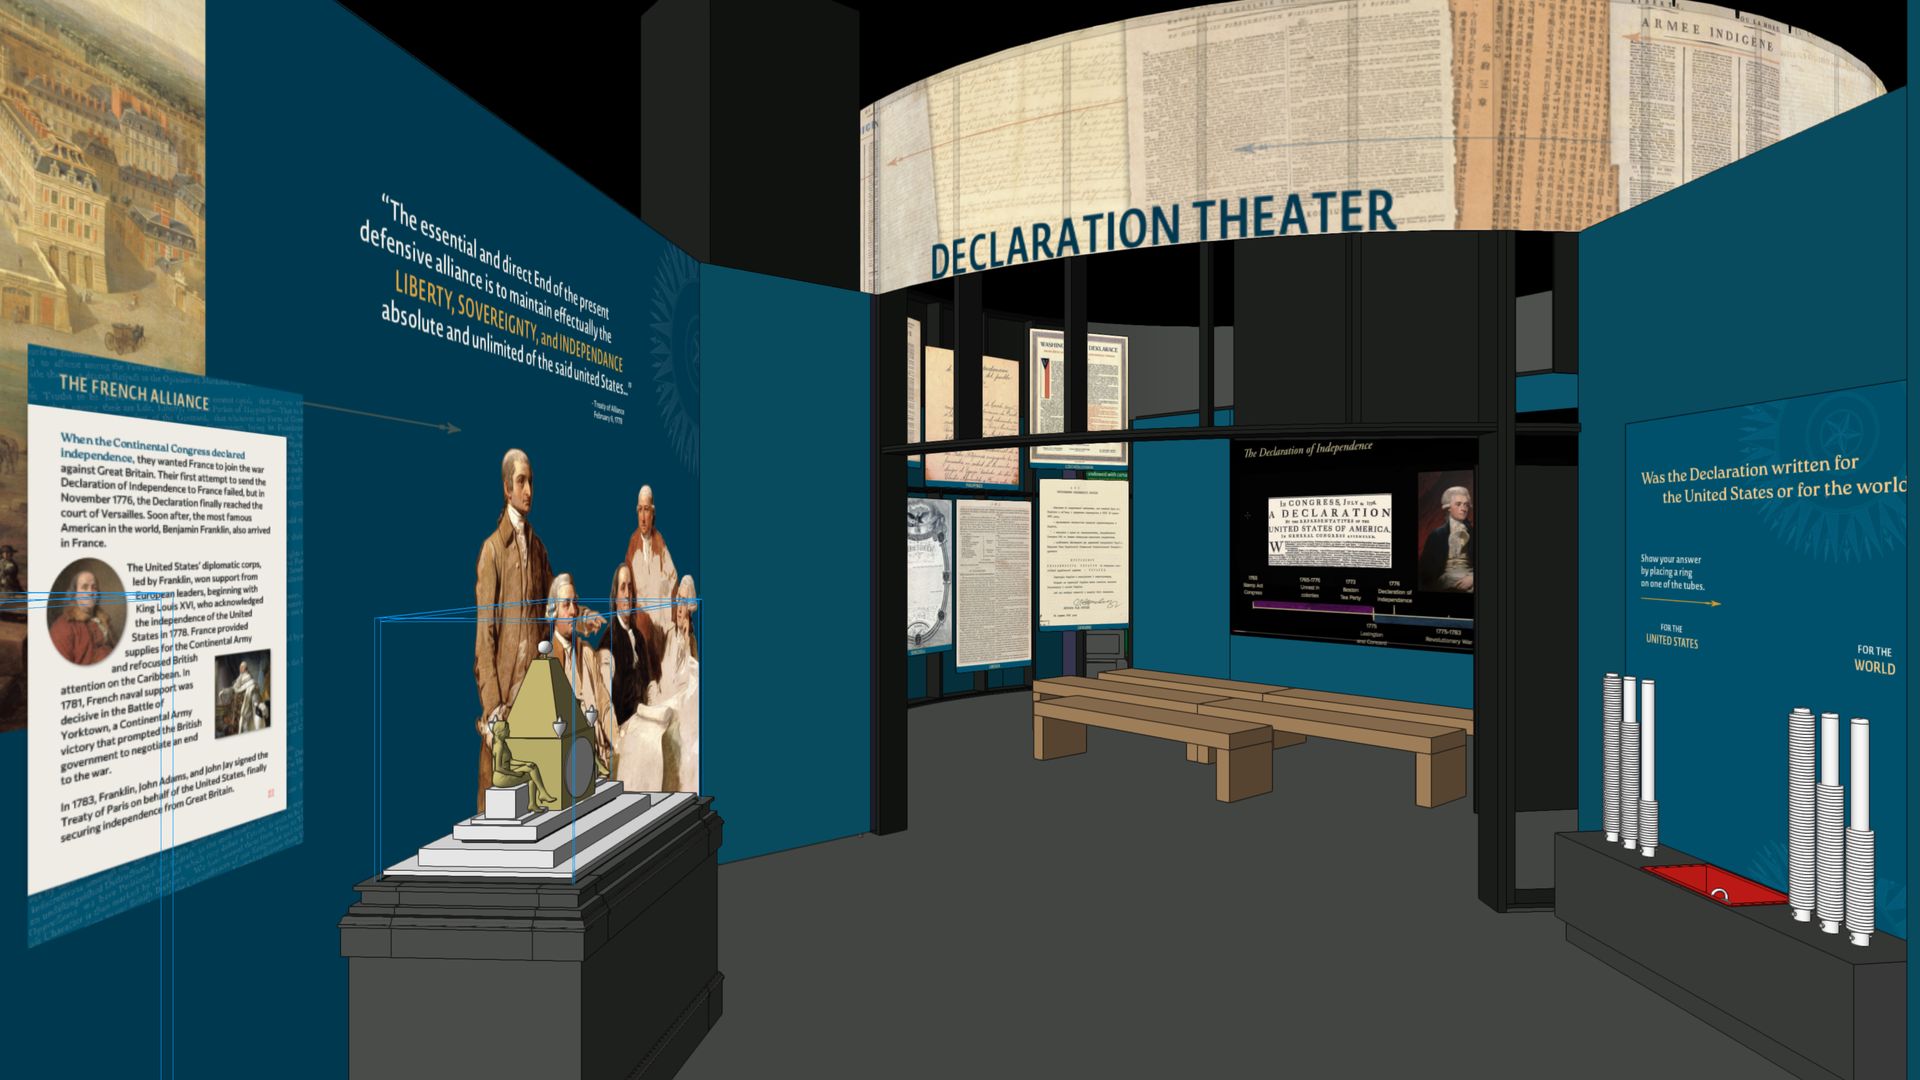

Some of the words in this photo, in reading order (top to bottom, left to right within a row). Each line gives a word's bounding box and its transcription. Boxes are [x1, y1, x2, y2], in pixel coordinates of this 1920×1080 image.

[1642, 18, 1700, 35] ARMEE
[1710, 26, 1774, 52] INDIGENE
[931, 204, 1180, 280] DECLARATION
[1192, 189, 1398, 241] THEATER
[421, 220, 476, 258] essential
[480, 248, 500, 269] and
[503, 255, 532, 284] direct
[535, 271, 551, 293] End
[553, 280, 563, 298] of
[564, 286, 578, 306] the
[580, 297, 609, 320] present
[360, 220, 432, 269] defensive
[436, 254, 482, 289] alliance
[486, 274, 493, 294] is
[496, 282, 507, 299] to
[510, 290, 552, 318] maintain
[554, 307, 598, 341] effectually
[600, 326, 611, 343] the
[395, 270, 455, 315] LIBERTY,
[459, 295, 538, 344] SOVEREIGNTY,
[541, 331, 558, 351] and
[559, 334, 623, 373] INDEPENDANCE
[382, 300, 443, 337] absolute
[447, 326, 469, 345] and
[473, 333, 524, 362] unlimited
[526, 350, 537, 368] of
[538, 352, 553, 372] the
[556, 361, 572, 378] said
[574, 368, 599, 386] united
[60, 374, 87, 392] THE
[92, 380, 147, 400] FRENCH
[151, 390, 208, 410] ALLIANCE
[61, 432, 93, 445] When
[95, 437, 112, 446] the
[114, 439, 169, 452] Continental
[171, 444, 210, 456] Congress
[212, 449, 245, 459] declared
[1245, 449, 1257, 458] The
[1260, 446, 1304, 457] Declaration
[1306, 443, 1316, 456] of
[1317, 440, 1373, 455] Independence
[61, 448, 135, 464] independence,
[137, 455, 156, 466] they
[158, 459, 188, 468] wanted
[189, 460, 214, 470] France
[216, 462, 224, 471] to
[225, 462, 238, 472] join
[239, 464, 251, 473] the
[1642, 472, 1665, 484] Was
[1668, 470, 1687, 482] the
[1690, 464, 1768, 481] Declaration
[1772, 459, 1830, 475] written
[1836, 455, 1859, 470] for
[61, 464, 96, 475] against
[98, 466, 123, 477] Great
[126, 468, 156, 479] Britain.
[158, 470, 179, 480] Their
[180, 472, 196, 482] first
[198, 475, 228, 485] attempt
[229, 476, 237, 484] to
[255, 478, 266, 486] the
[1664, 491, 1682, 503] the
[1685, 487, 1727, 502] United
[1731, 486, 1773, 500] States
[1778, 488, 1793, 498] or
[1798, 482, 1820, 497] for
[1825, 480, 1852, 496] the
[1269, 511, 1275, 519] A
[1282, 508, 1391, 518] DECLARATION
[1289, 499, 1341, 507] CONGRESS,
[1349, 525, 1391, 533] AMERICA,
[127, 563, 143, 572] The
[145, 562, 173, 572] United
[174, 562, 201, 571] States'
[202, 561, 240, 571] diplomatic
[242, 562, 262, 570] corps,
[1660, 557, 1674, 565] your
[1642, 568, 1649, 576] by
[1650, 568, 1673, 578] placing
[1680, 570, 1692, 579] ring
[1664, 580, 1670, 588] of
[1672, 581, 1682, 589] the
[1684, 582, 1704, 590] tubes.
[1673, 625, 1682, 633] THE
[1647, 634, 1672, 645] UNITED
[1674, 637, 1698, 649] STATES
[1858, 645, 1874, 655] FOR
[1876, 647, 1891, 657] THE
[1855, 660, 1896, 675] WORLD
[61, 803, 70, 812] In
[72, 796, 97, 809] 1783,
[99, 786, 137, 802] Franklin,
[139, 781, 158, 793] John
[160, 774, 189, 786] Adams,
[190, 767, 204, 778] and
[206, 764, 222, 775] John
[223, 762, 233, 771] Jay
[234, 753, 256, 767] signed
[258, 752, 268, 760] the
[61, 825, 101, 843] securing
[103, 808, 163, 830] independence
[164, 801, 184, 812] from
[186, 793, 207, 806] Great
[208, 786, 234, 799] Britain.
